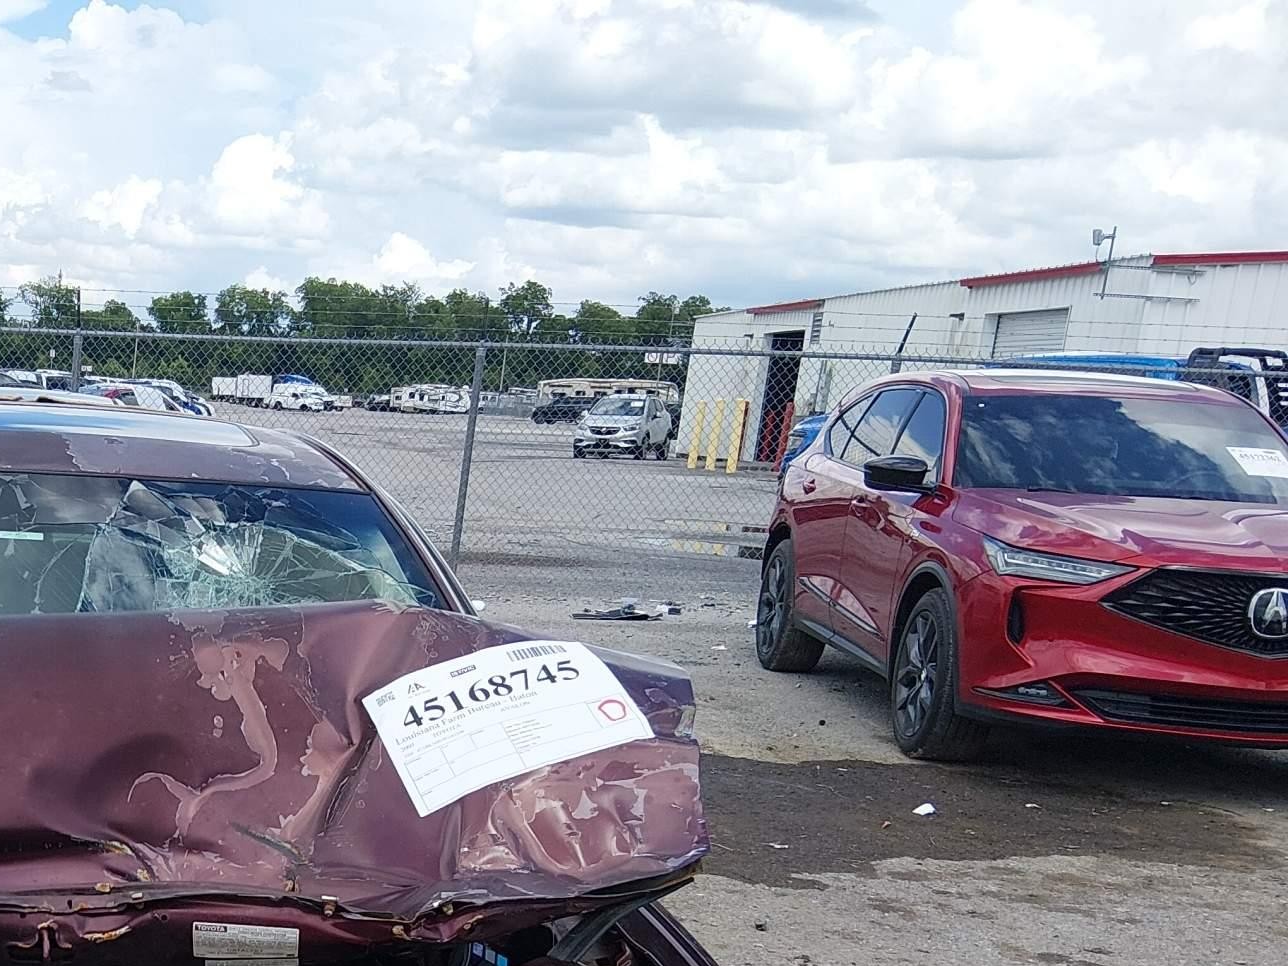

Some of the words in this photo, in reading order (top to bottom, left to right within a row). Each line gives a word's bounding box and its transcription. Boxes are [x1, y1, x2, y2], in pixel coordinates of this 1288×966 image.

[402, 660, 580, 728] 45168745
[395, 722, 441, 746] Louisiana
[441, 711, 467, 727] Farm
[197, 924, 225, 932] TOYOTA
